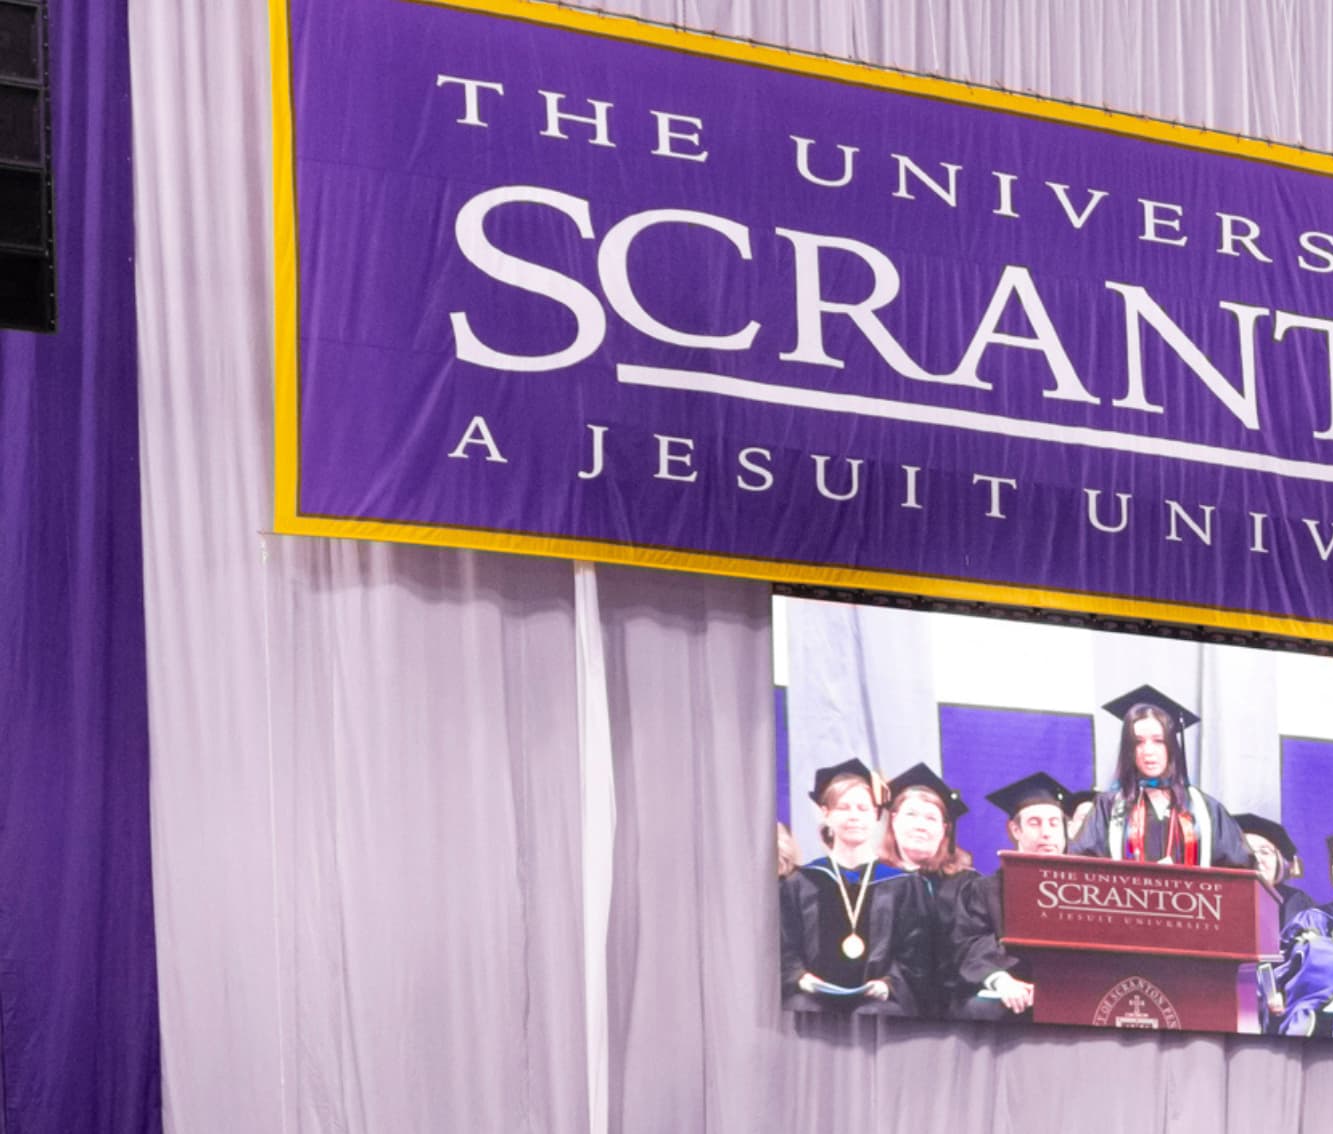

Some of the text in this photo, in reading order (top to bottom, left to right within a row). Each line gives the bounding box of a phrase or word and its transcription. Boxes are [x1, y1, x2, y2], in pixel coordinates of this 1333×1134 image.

[437, 74, 708, 161] THE
[448, 416, 507, 462] A
[579, 424, 1017, 518] JESUIT
[1037, 880, 1223, 920] SCRANTON
[1039, 870, 1223, 892] THE UNIVERSITY OF
[1059, 913, 1113, 924] JESUIT
[1125, 917, 1220, 931] UNIVERSITY
